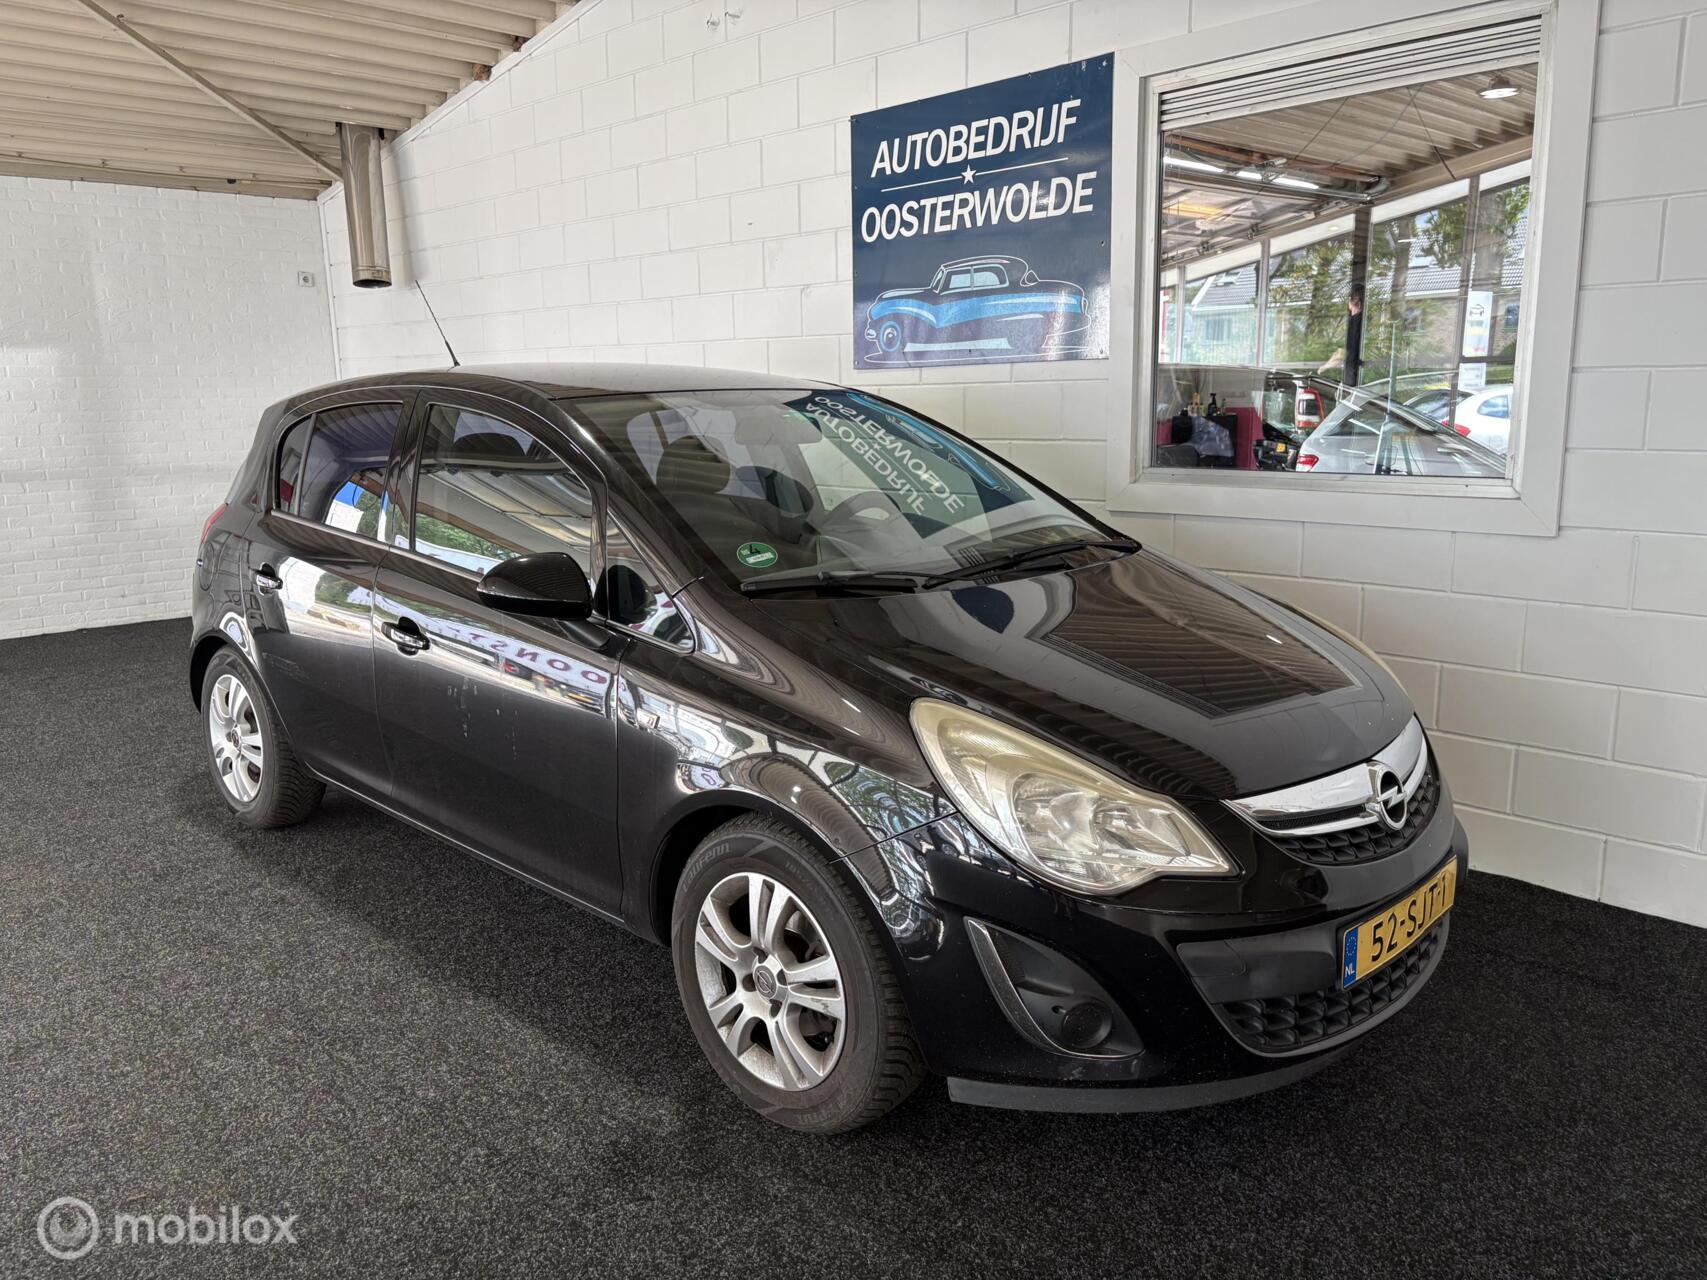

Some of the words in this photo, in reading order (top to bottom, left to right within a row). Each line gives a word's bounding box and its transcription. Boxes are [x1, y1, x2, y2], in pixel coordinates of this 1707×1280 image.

[870, 99, 1081, 178] AUTOBEDRIJF
[861, 171, 1098, 243] OOSTERWOLDE
[1370, 873, 1447, 962] 52-SJT-1
[1344, 964, 1355, 978] NL
